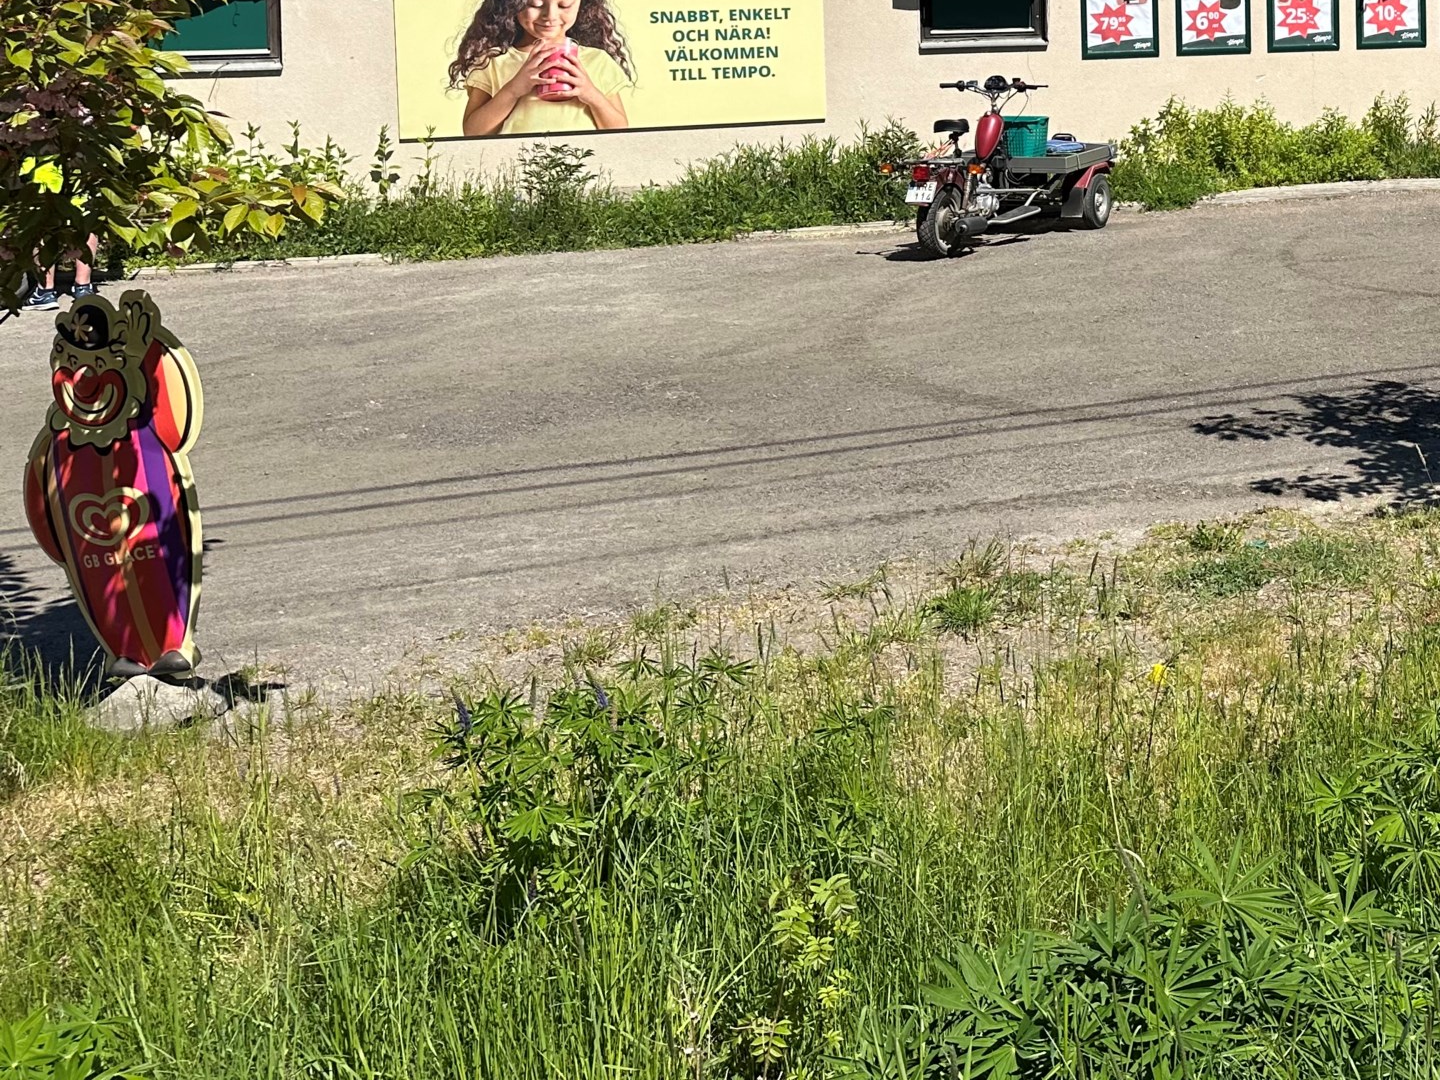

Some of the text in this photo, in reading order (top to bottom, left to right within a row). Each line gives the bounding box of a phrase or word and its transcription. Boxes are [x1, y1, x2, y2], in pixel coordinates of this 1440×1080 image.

[649, 7, 791, 24] SNABBT, ENKELT
[672, 25, 771, 42] OCH NÄRA!
[664, 46, 779, 62] VÄLKOMMEN
[669, 65, 776, 81] TILL TEMPO.
[83, 544, 155, 568] GB GLACE
